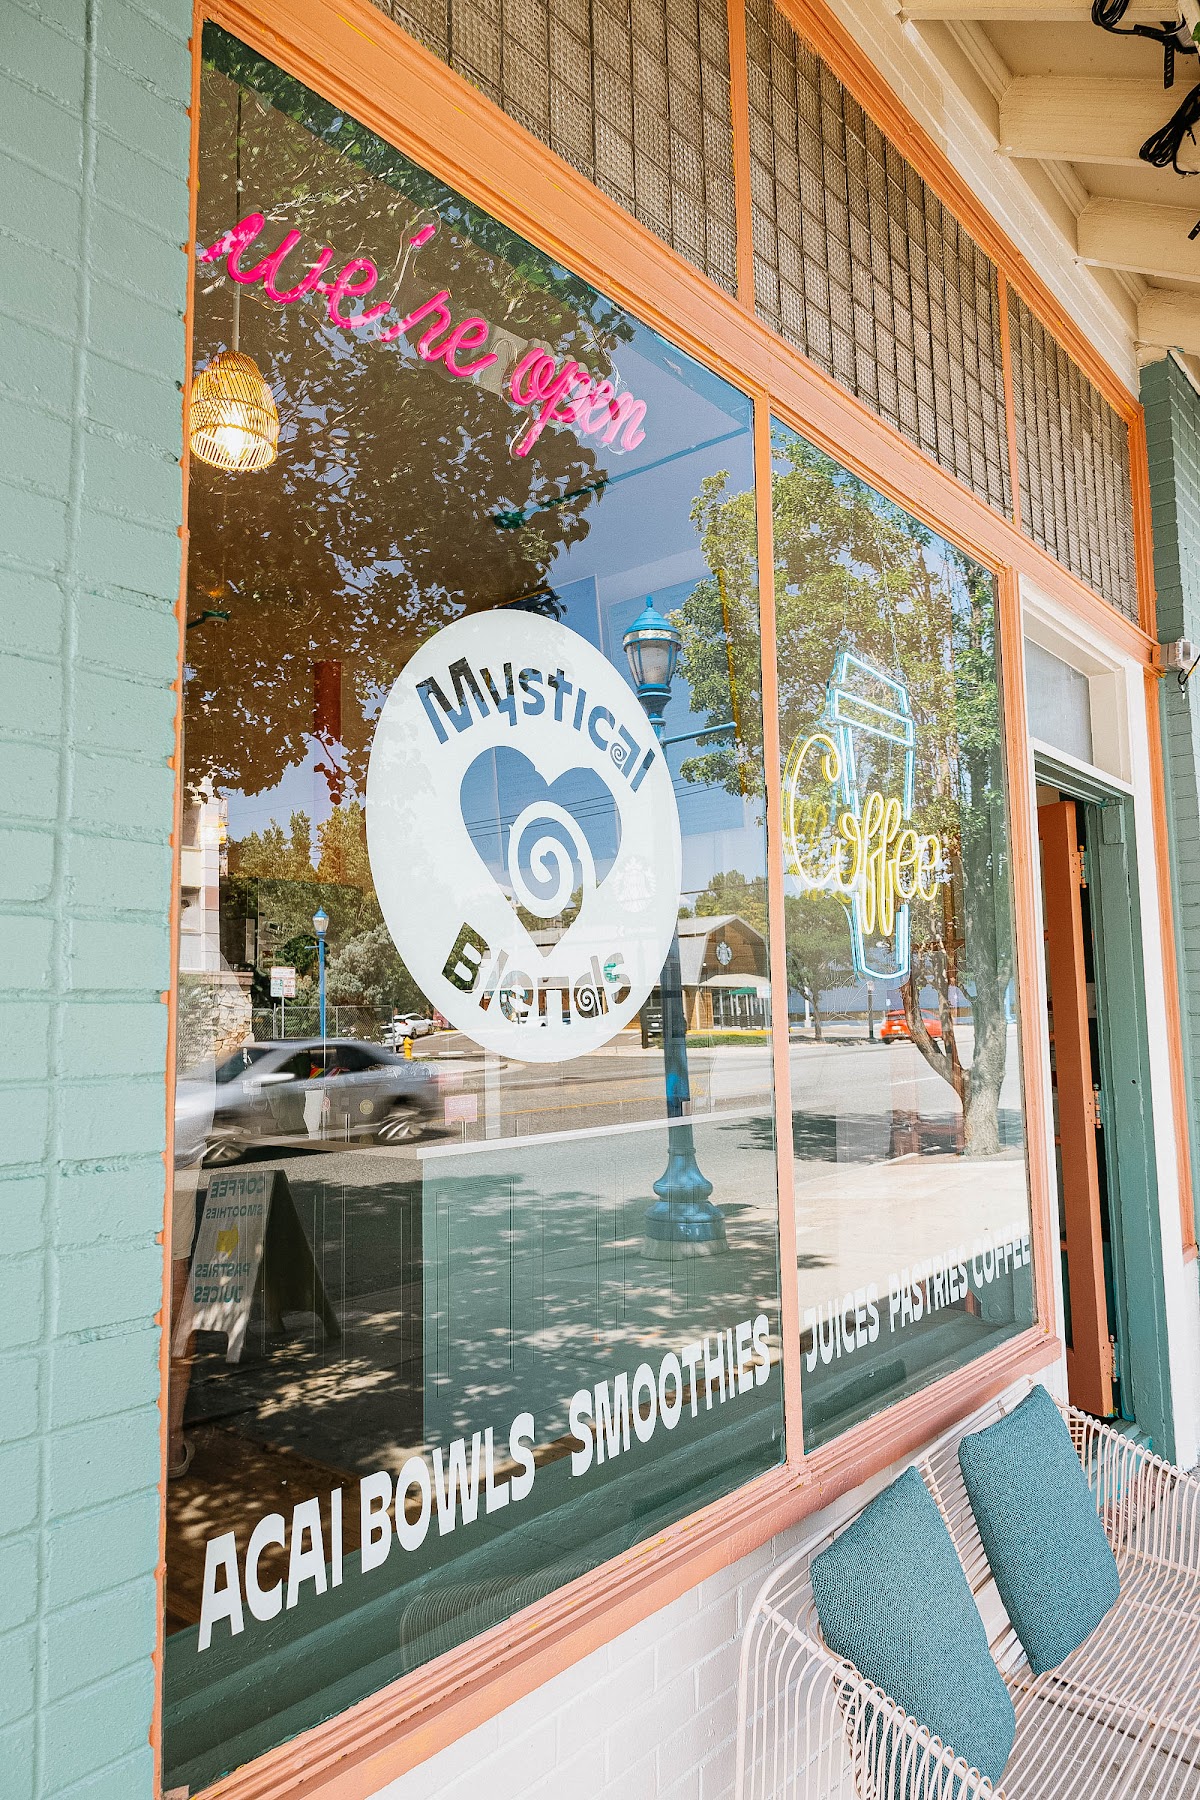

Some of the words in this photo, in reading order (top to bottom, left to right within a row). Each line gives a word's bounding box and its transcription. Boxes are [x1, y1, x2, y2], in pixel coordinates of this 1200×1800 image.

[510, 347, 647, 457] open
[785, 733, 940, 936] Coffee
[441, 922, 632, 1027] Blends
[803, 1282, 880, 1373] JUICES
[888, 1245, 969, 1333] PASTRIES
[972, 1219, 1031, 1289] COFFEE
[198, 1487, 343, 1652] ACAI
[360, 1412, 535, 1574] BOWLS
[569, 1314, 771, 1478] SMOOTHIES
